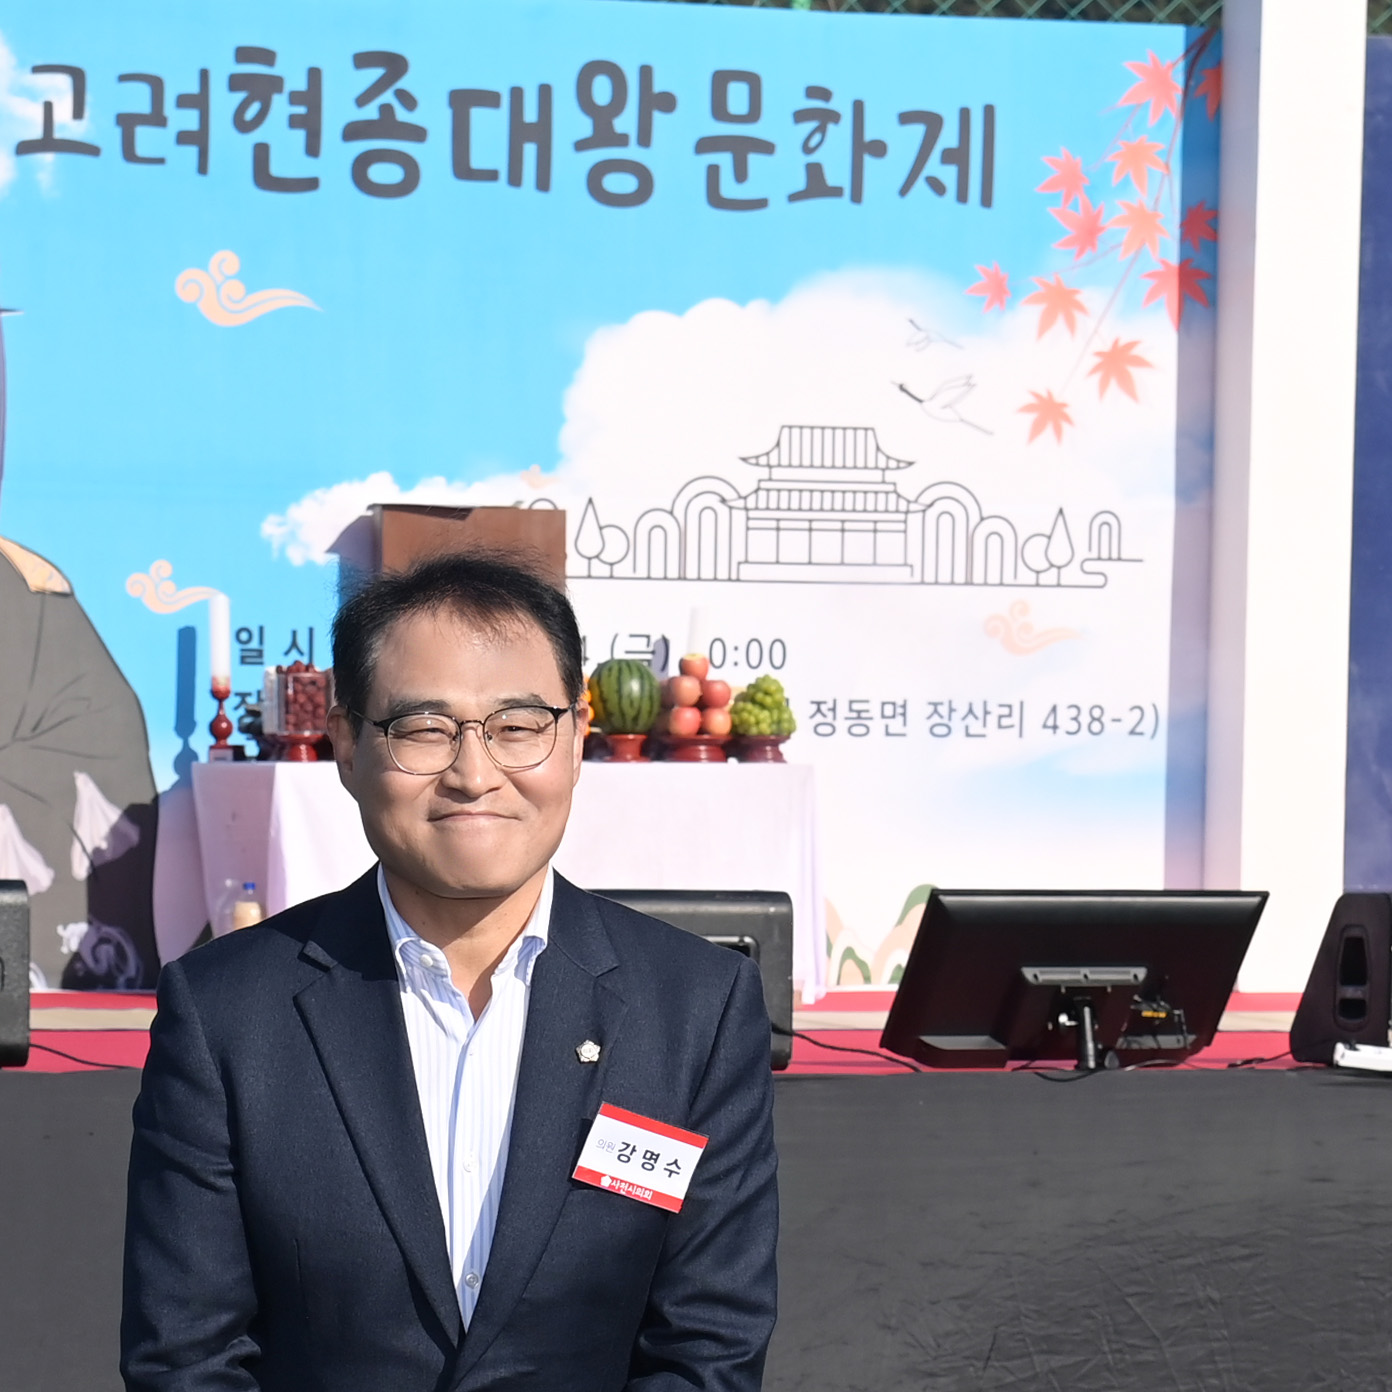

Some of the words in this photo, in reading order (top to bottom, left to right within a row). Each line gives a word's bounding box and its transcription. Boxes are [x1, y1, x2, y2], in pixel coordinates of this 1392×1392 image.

[708, 637, 787, 669] 0:00
[808, 698, 908, 738] 정동면
[926, 699, 1024, 739] 장산리
[1041, 702, 1161, 741] 438-2)
[595, 1138, 617, 1154] 의원
[611, 1179, 654, 1201] 사천시의회
